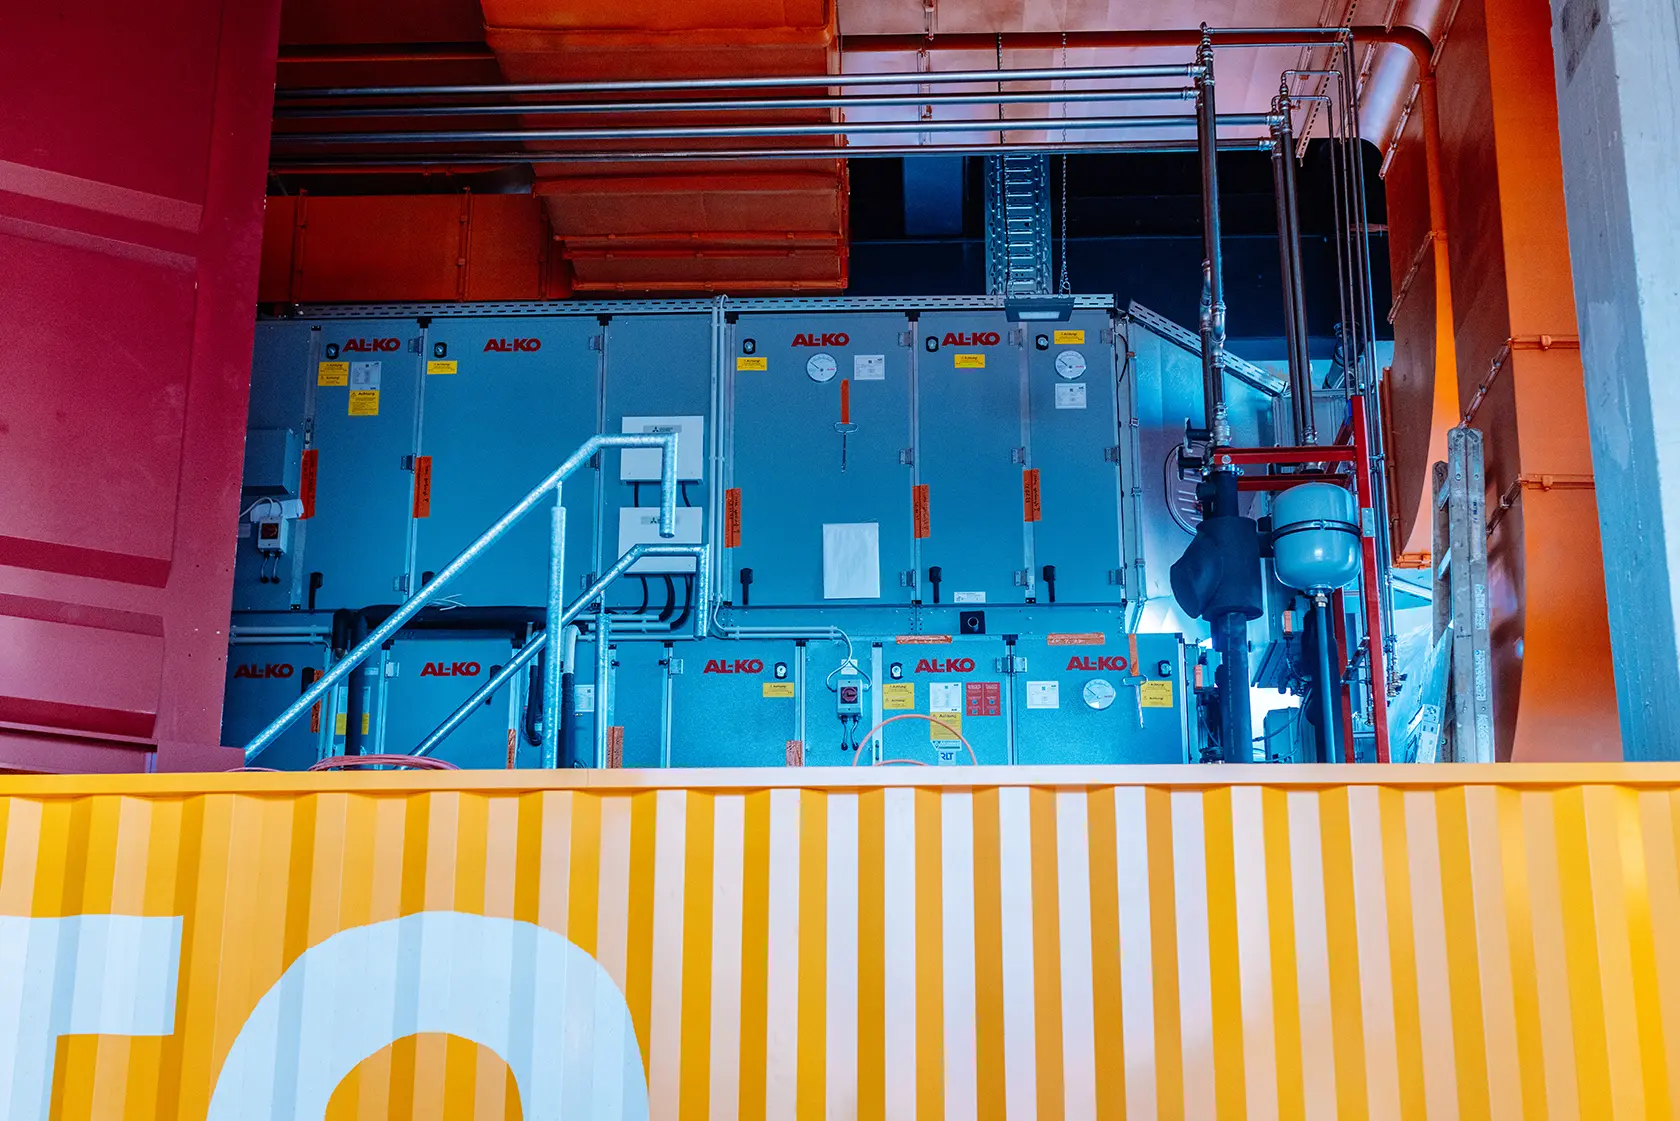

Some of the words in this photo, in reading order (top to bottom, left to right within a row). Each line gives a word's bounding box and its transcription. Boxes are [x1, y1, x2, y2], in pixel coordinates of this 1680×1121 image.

[343, 337, 400, 352] AL-KO
[483, 338, 541, 352] AL-KO
[791, 332, 850, 347] AL-KO
[942, 331, 1000, 346] AL-KO
[234, 663, 294, 678] AL-KO
[420, 661, 481, 676] AL-KO
[704, 659, 764, 674] AL-KO
[915, 658, 975, 673] AL-KO
[1066, 656, 1127, 671] AL-KO
